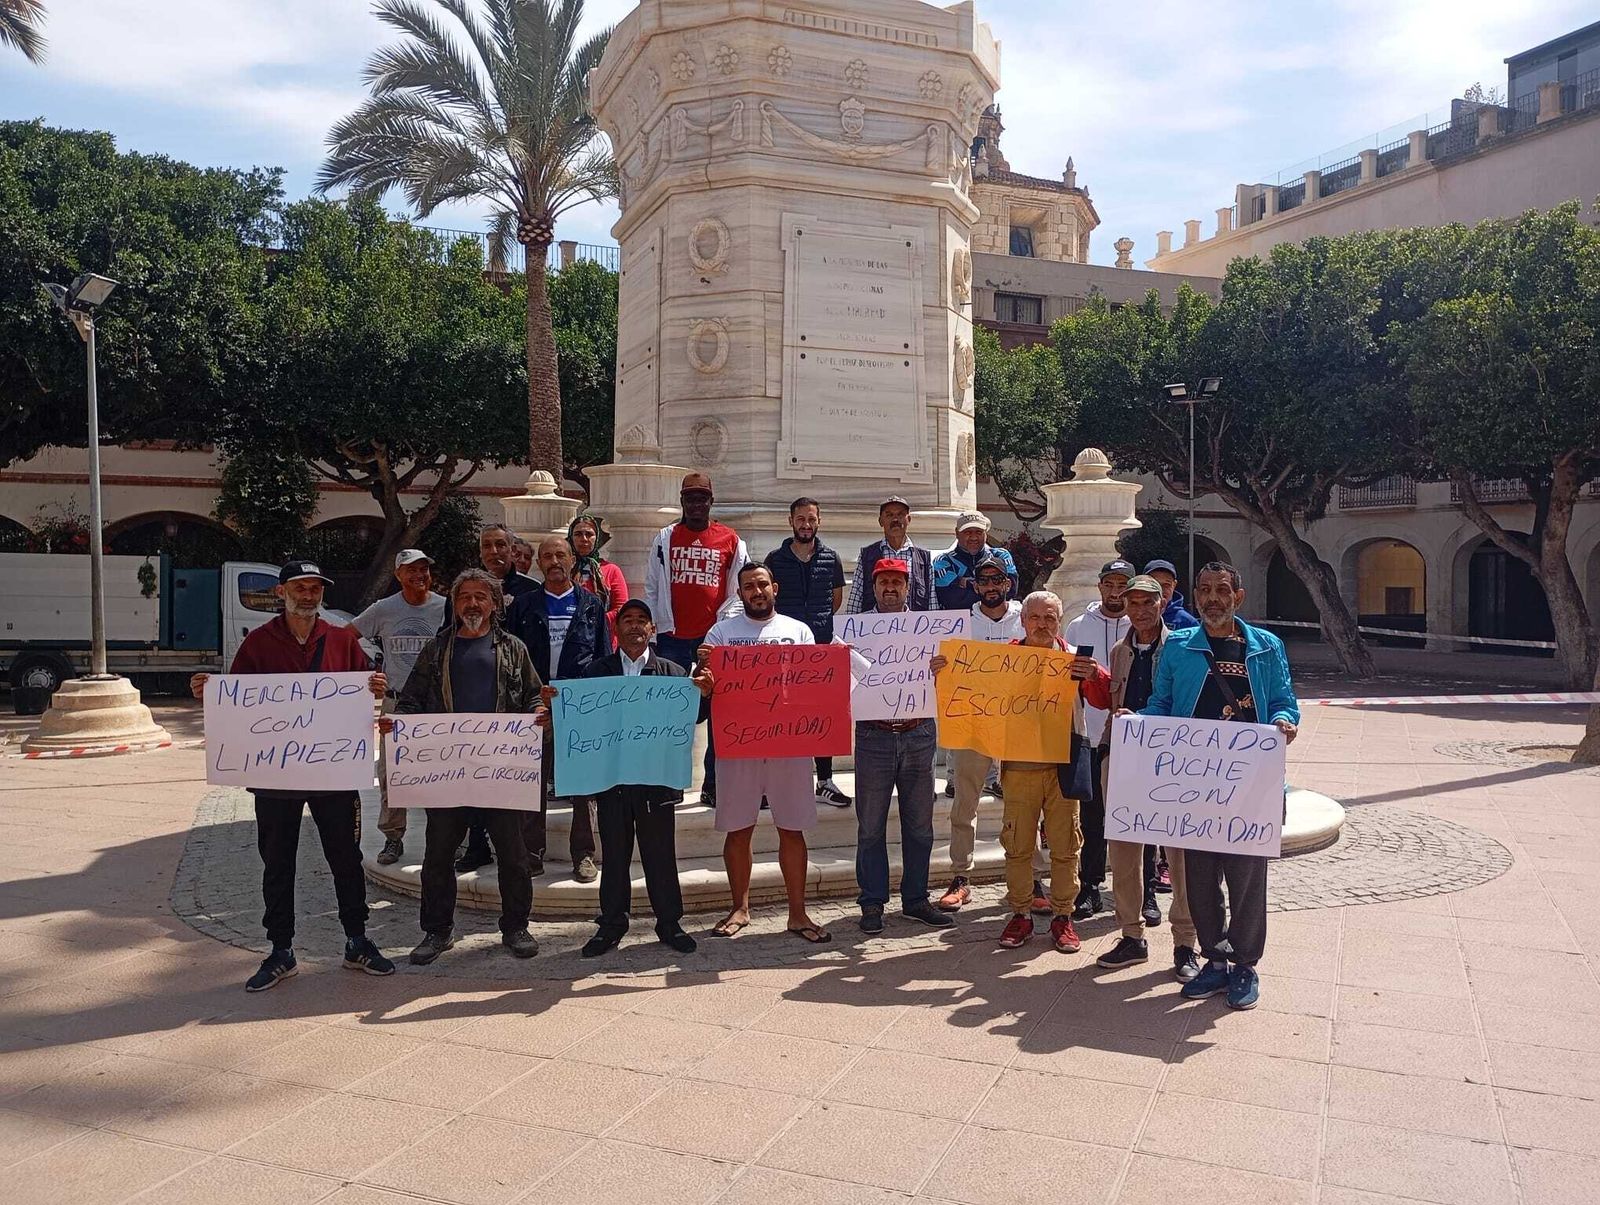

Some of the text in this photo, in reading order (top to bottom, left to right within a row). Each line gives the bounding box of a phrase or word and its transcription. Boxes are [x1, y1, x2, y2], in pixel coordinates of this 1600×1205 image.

[671, 546, 721, 562] THERE
[670, 559, 722, 575] WILL BE
[670, 571, 720, 588] HATERS
[843, 615, 964, 639] ALCALDESA
[722, 649, 827, 671] MERCADO
[951, 644, 1073, 678] ALCALDESA
[750, 667, 834, 691] LIMPIEZA
[218, 676, 364, 707] MERCADO
[755, 694, 779, 712] Y
[945, 686, 1061, 718] ESCUCHA
[250, 708, 314, 734] CON
[392, 718, 539, 742] RECICLAMOS
[723, 715, 832, 748] SEGURIDAD
[568, 723, 691, 758] REUTILIZAMOS
[1123, 720, 1277, 751] MERCADO
[216, 738, 367, 772] LIMPIEZA
[395, 743, 542, 765] REUTILIZAMOS
[1154, 751, 1250, 781] PUCHE
[389, 766, 540, 787] ECONOMIA CIRCULAR
[1149, 782, 1236, 806] CON
